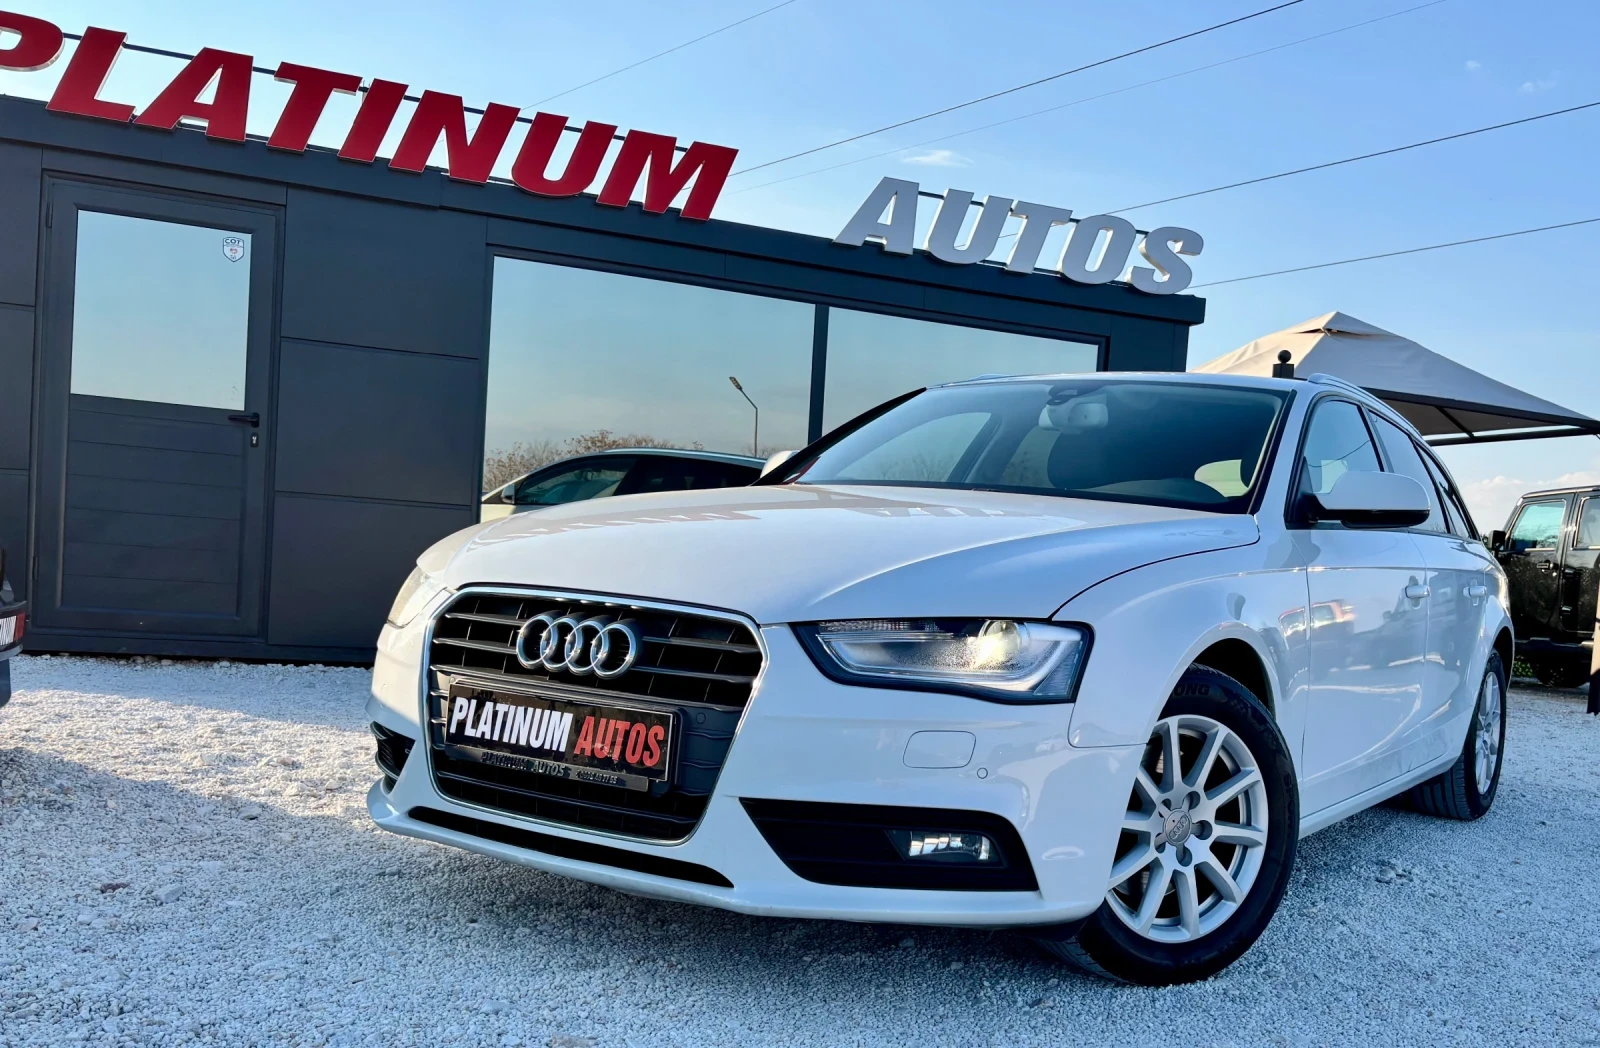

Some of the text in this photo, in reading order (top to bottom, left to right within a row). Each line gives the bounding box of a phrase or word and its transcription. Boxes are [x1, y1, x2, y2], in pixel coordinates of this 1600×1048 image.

[831, 176, 1204, 295] AUTOS
[450, 697, 665, 767] PLATINUM AUTOS
[531, 760, 566, 777] AUTOS
